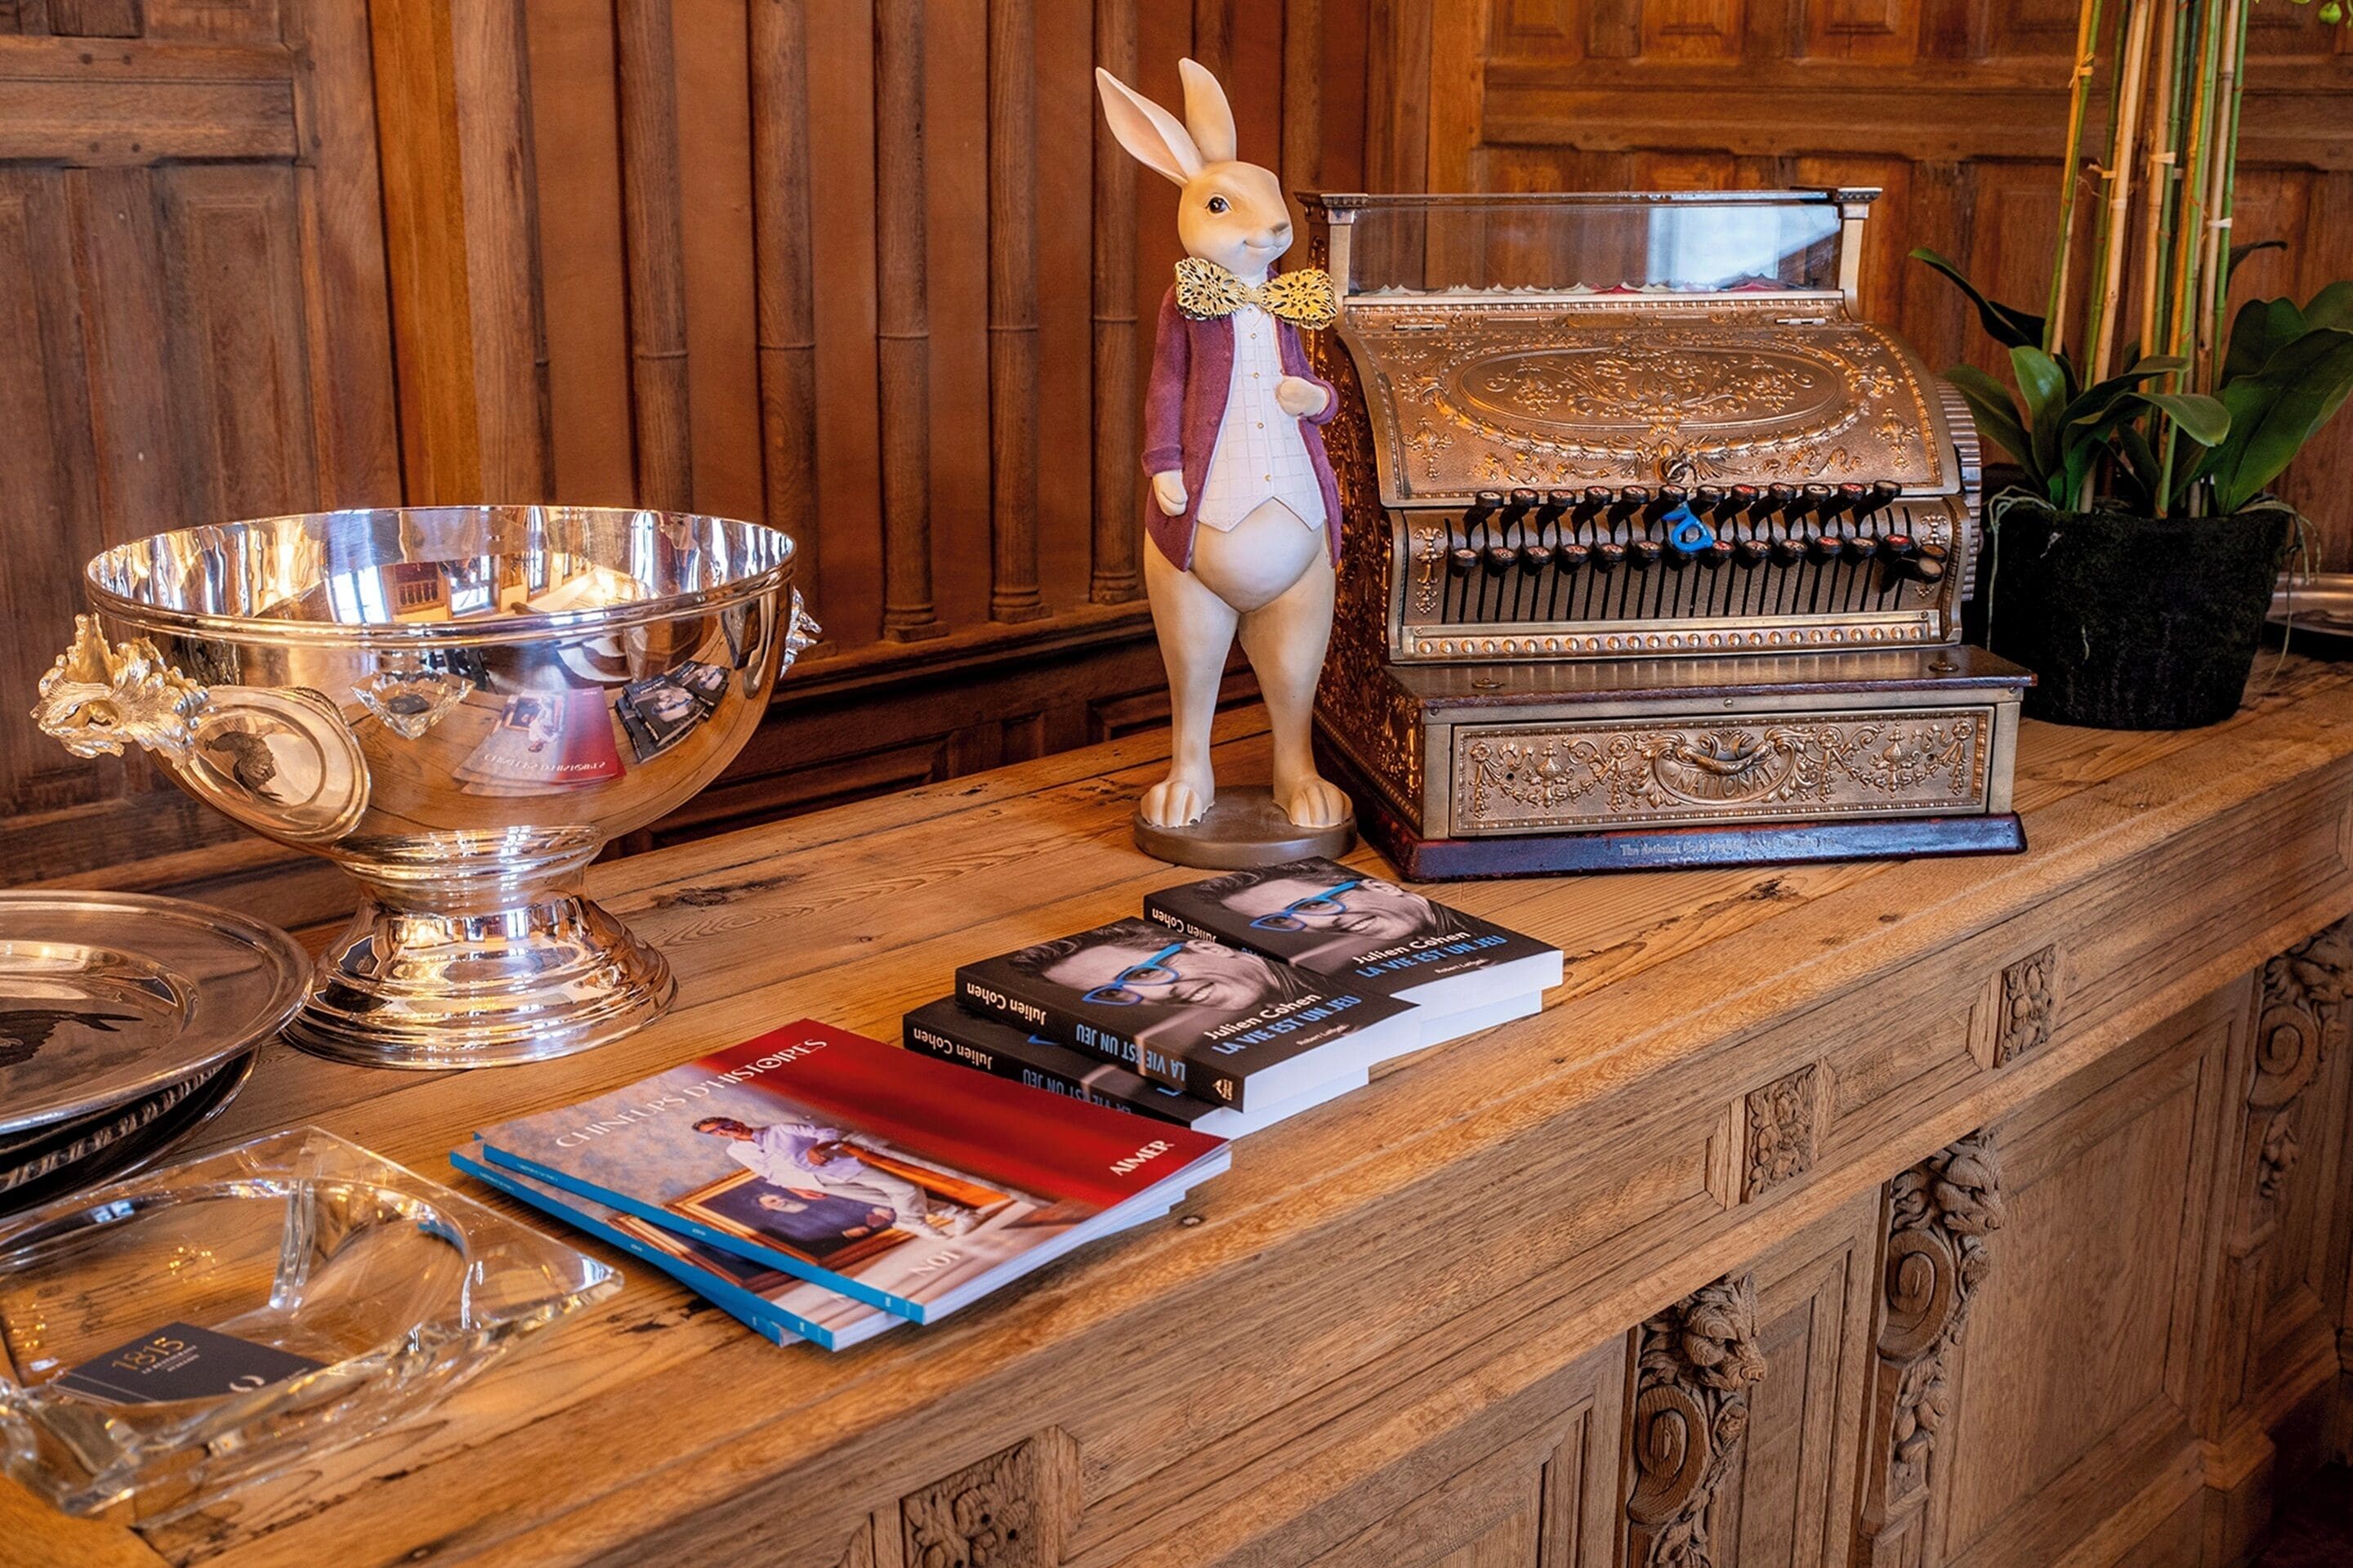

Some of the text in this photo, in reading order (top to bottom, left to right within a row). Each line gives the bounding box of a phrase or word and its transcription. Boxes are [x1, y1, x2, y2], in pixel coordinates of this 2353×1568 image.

[1675, 762, 1781, 797] NATIONAL
[1151, 908, 1184, 933] Cohen
[1352, 931, 1471, 965] Julien Cohen
[1355, 934, 1508, 979] LA VIE EST UN JEU
[967, 981, 1047, 1026] Julien Cohen
[1203, 993, 1322, 1040] Julien Cohen
[1211, 994, 1363, 1056] LA VIE EST UN JEU
[913, 1027, 993, 1070] Julien Cohen
[1075, 1023, 1187, 1083] LA VIE EST UN JEU
[1023, 1068, 1044, 1088] JEU
[1109, 1139, 1176, 1177] AIMER
[112, 1337, 185, 1370] 1815
